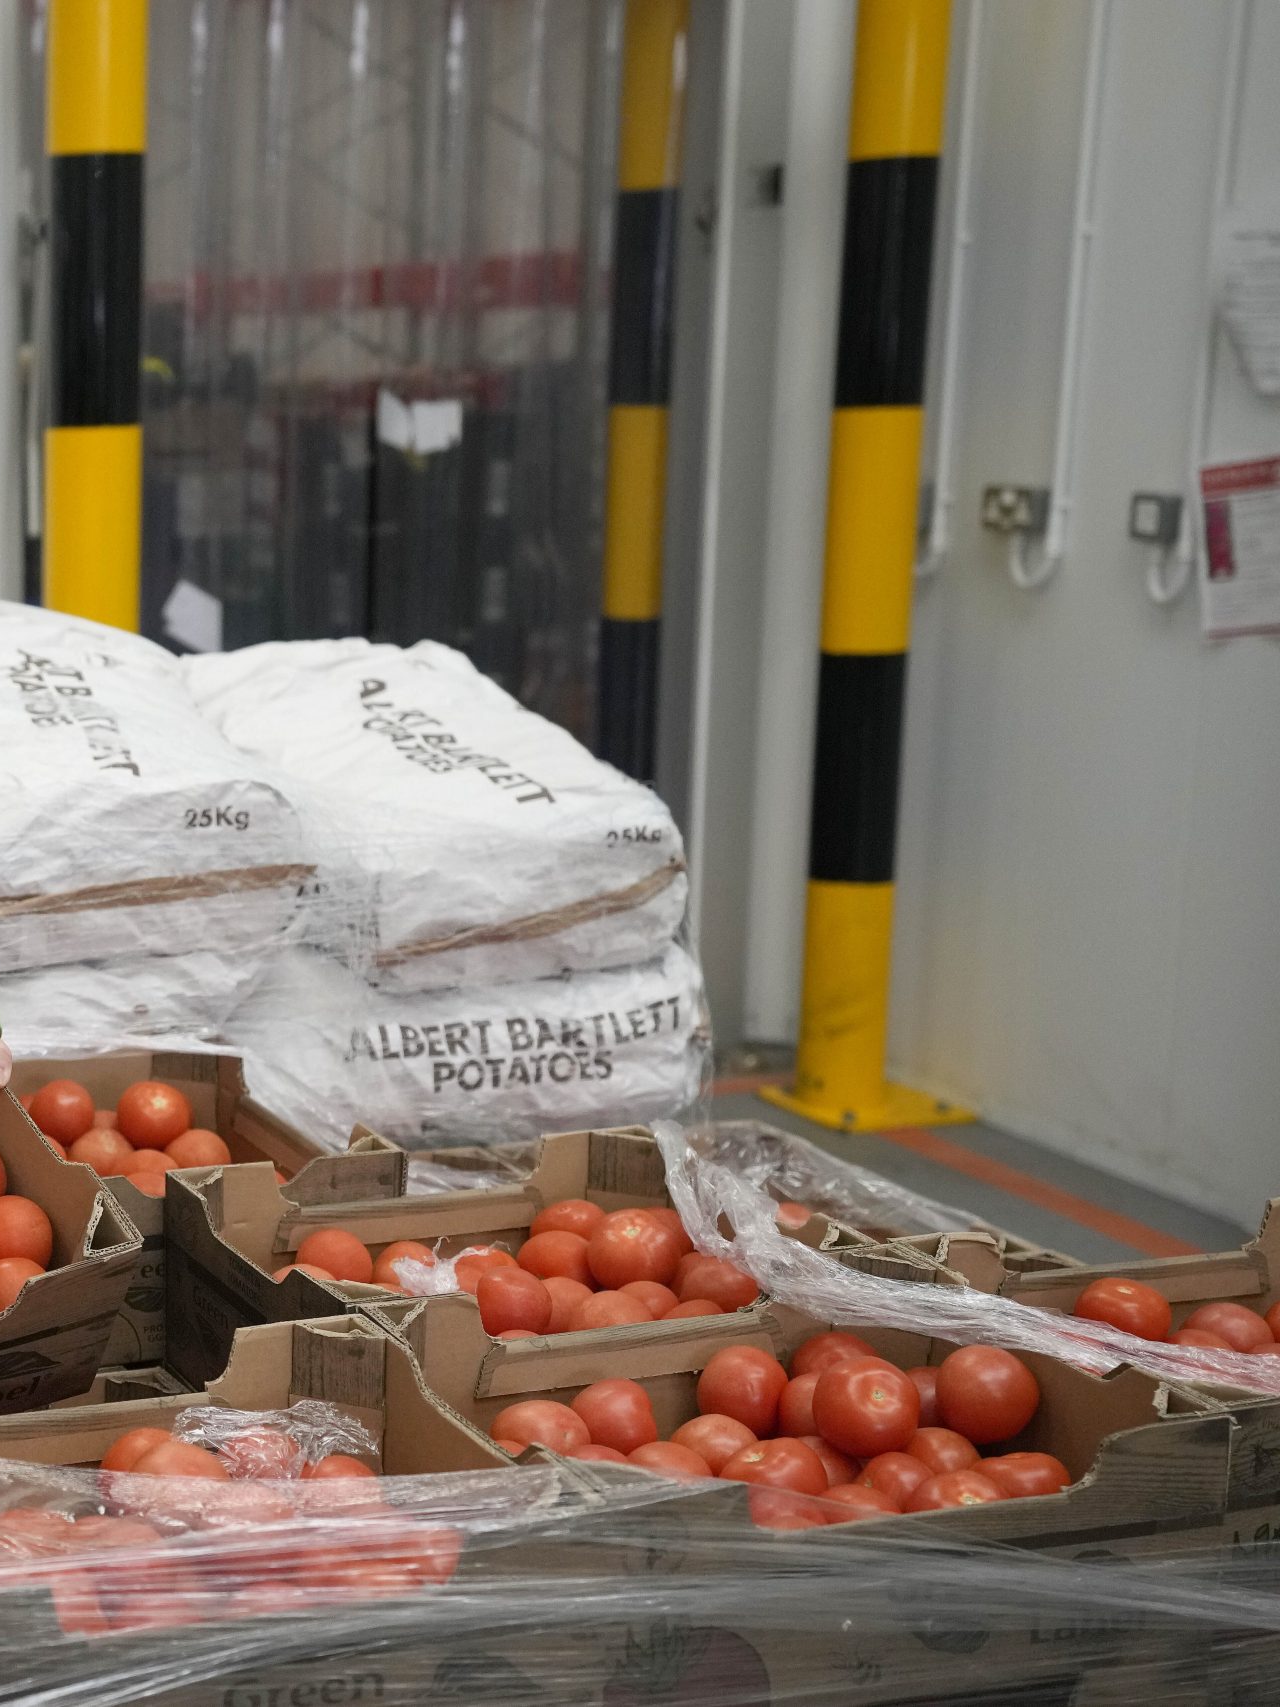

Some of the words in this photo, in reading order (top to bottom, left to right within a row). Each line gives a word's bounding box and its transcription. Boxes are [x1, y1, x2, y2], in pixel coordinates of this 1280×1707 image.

[184, 805, 251, 831] 25Kg
[345, 1019, 493, 1062] ALBERT
[506, 996, 681, 1053] BARTLETT
[433, 1051, 613, 1093] POTATOES
